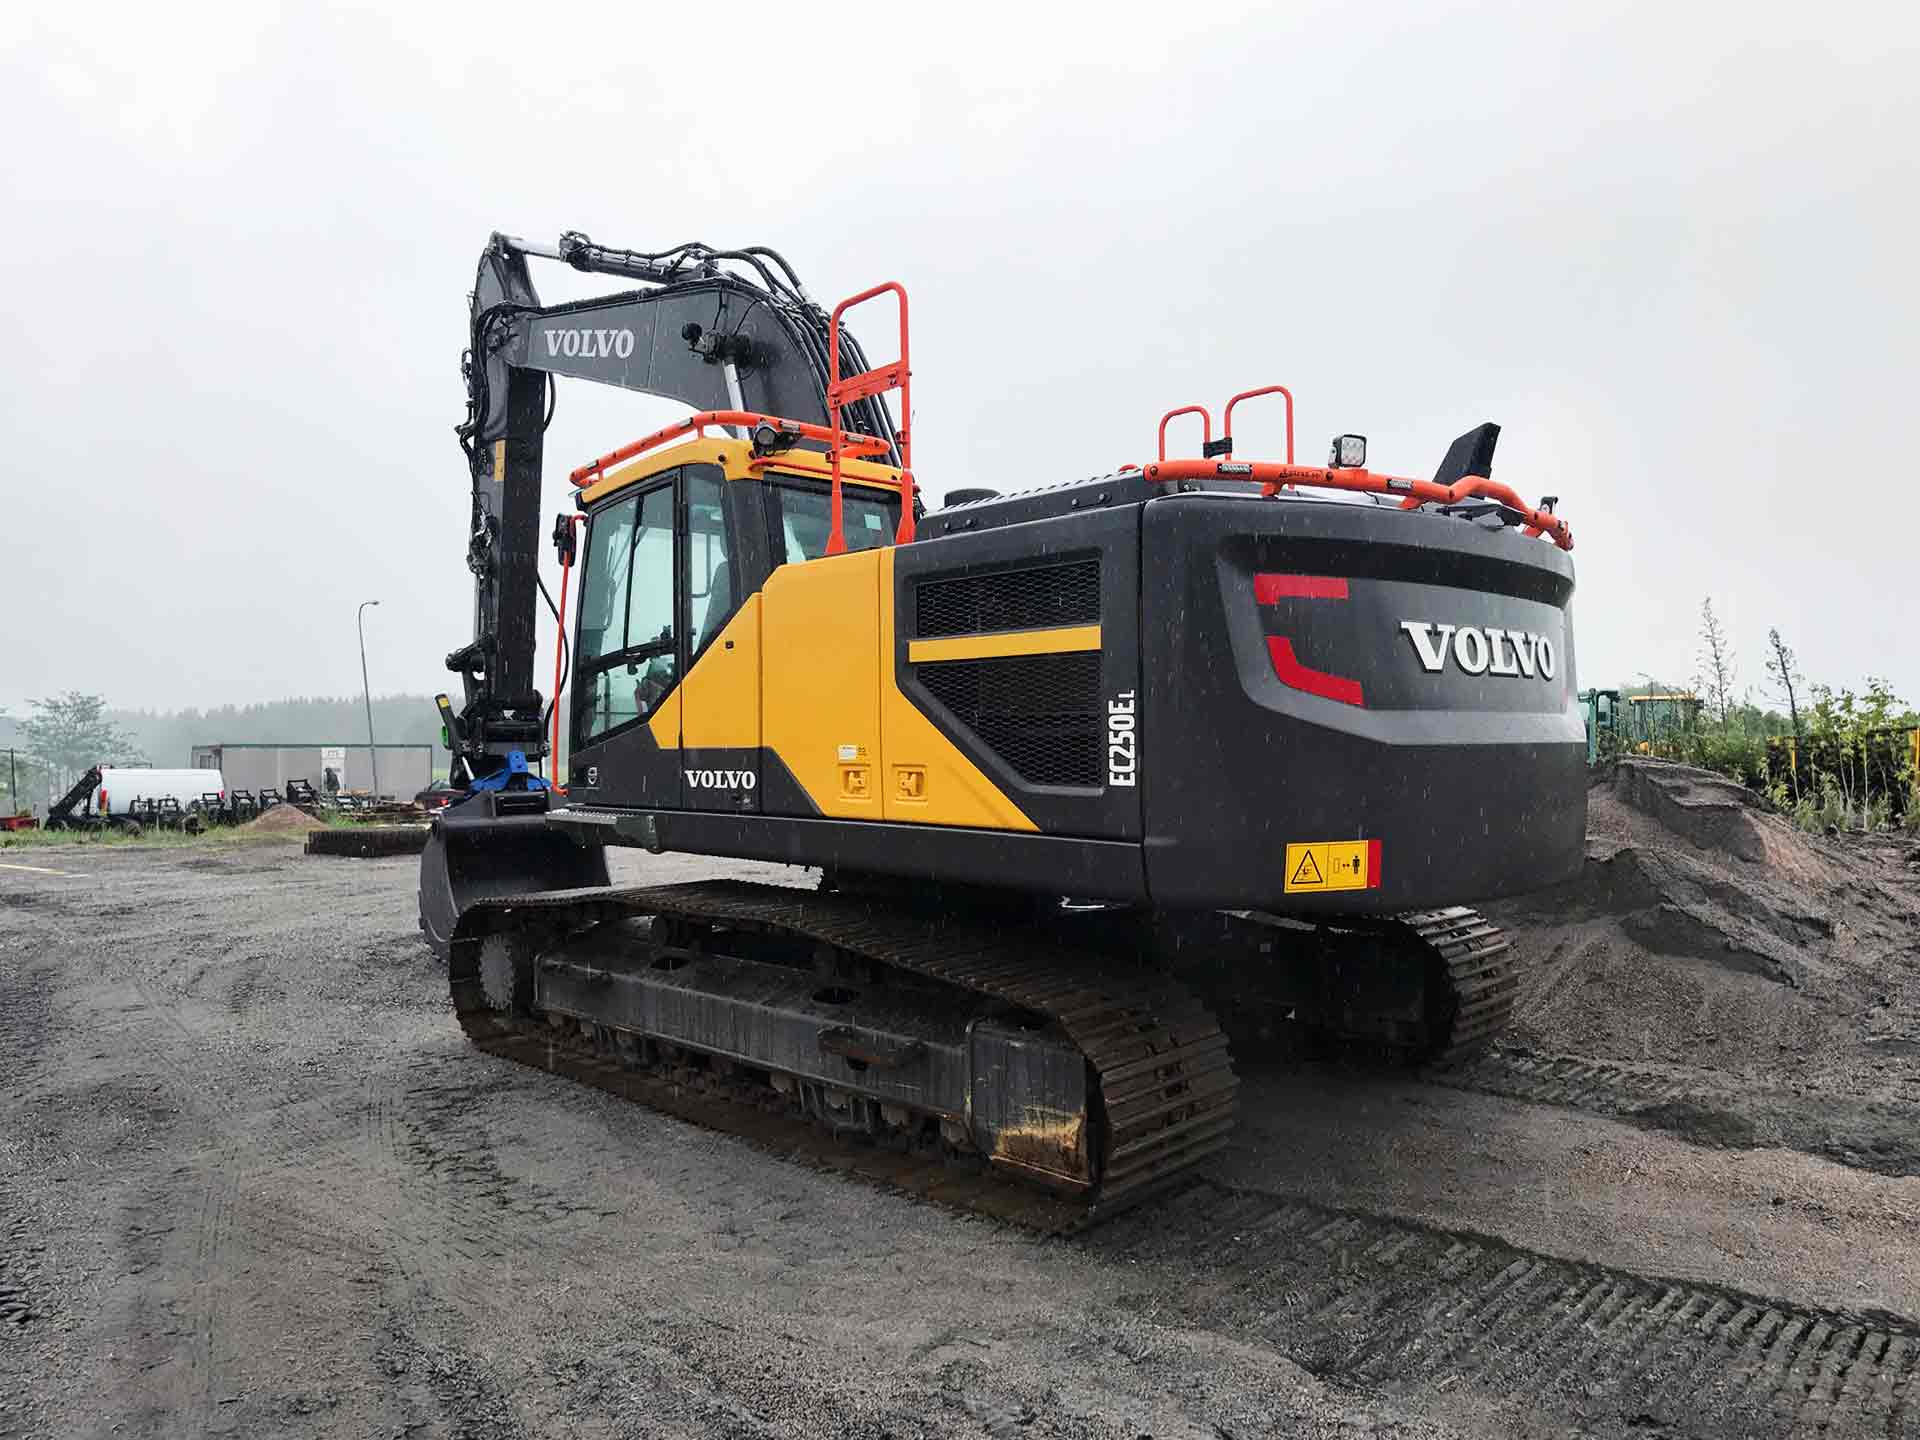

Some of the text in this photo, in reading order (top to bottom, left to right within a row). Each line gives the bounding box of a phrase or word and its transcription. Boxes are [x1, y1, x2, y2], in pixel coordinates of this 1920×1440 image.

[544, 328, 635, 359] VOLVO
[1400, 620, 1556, 681] VOLVO
[684, 769, 757, 789] VOLVO
